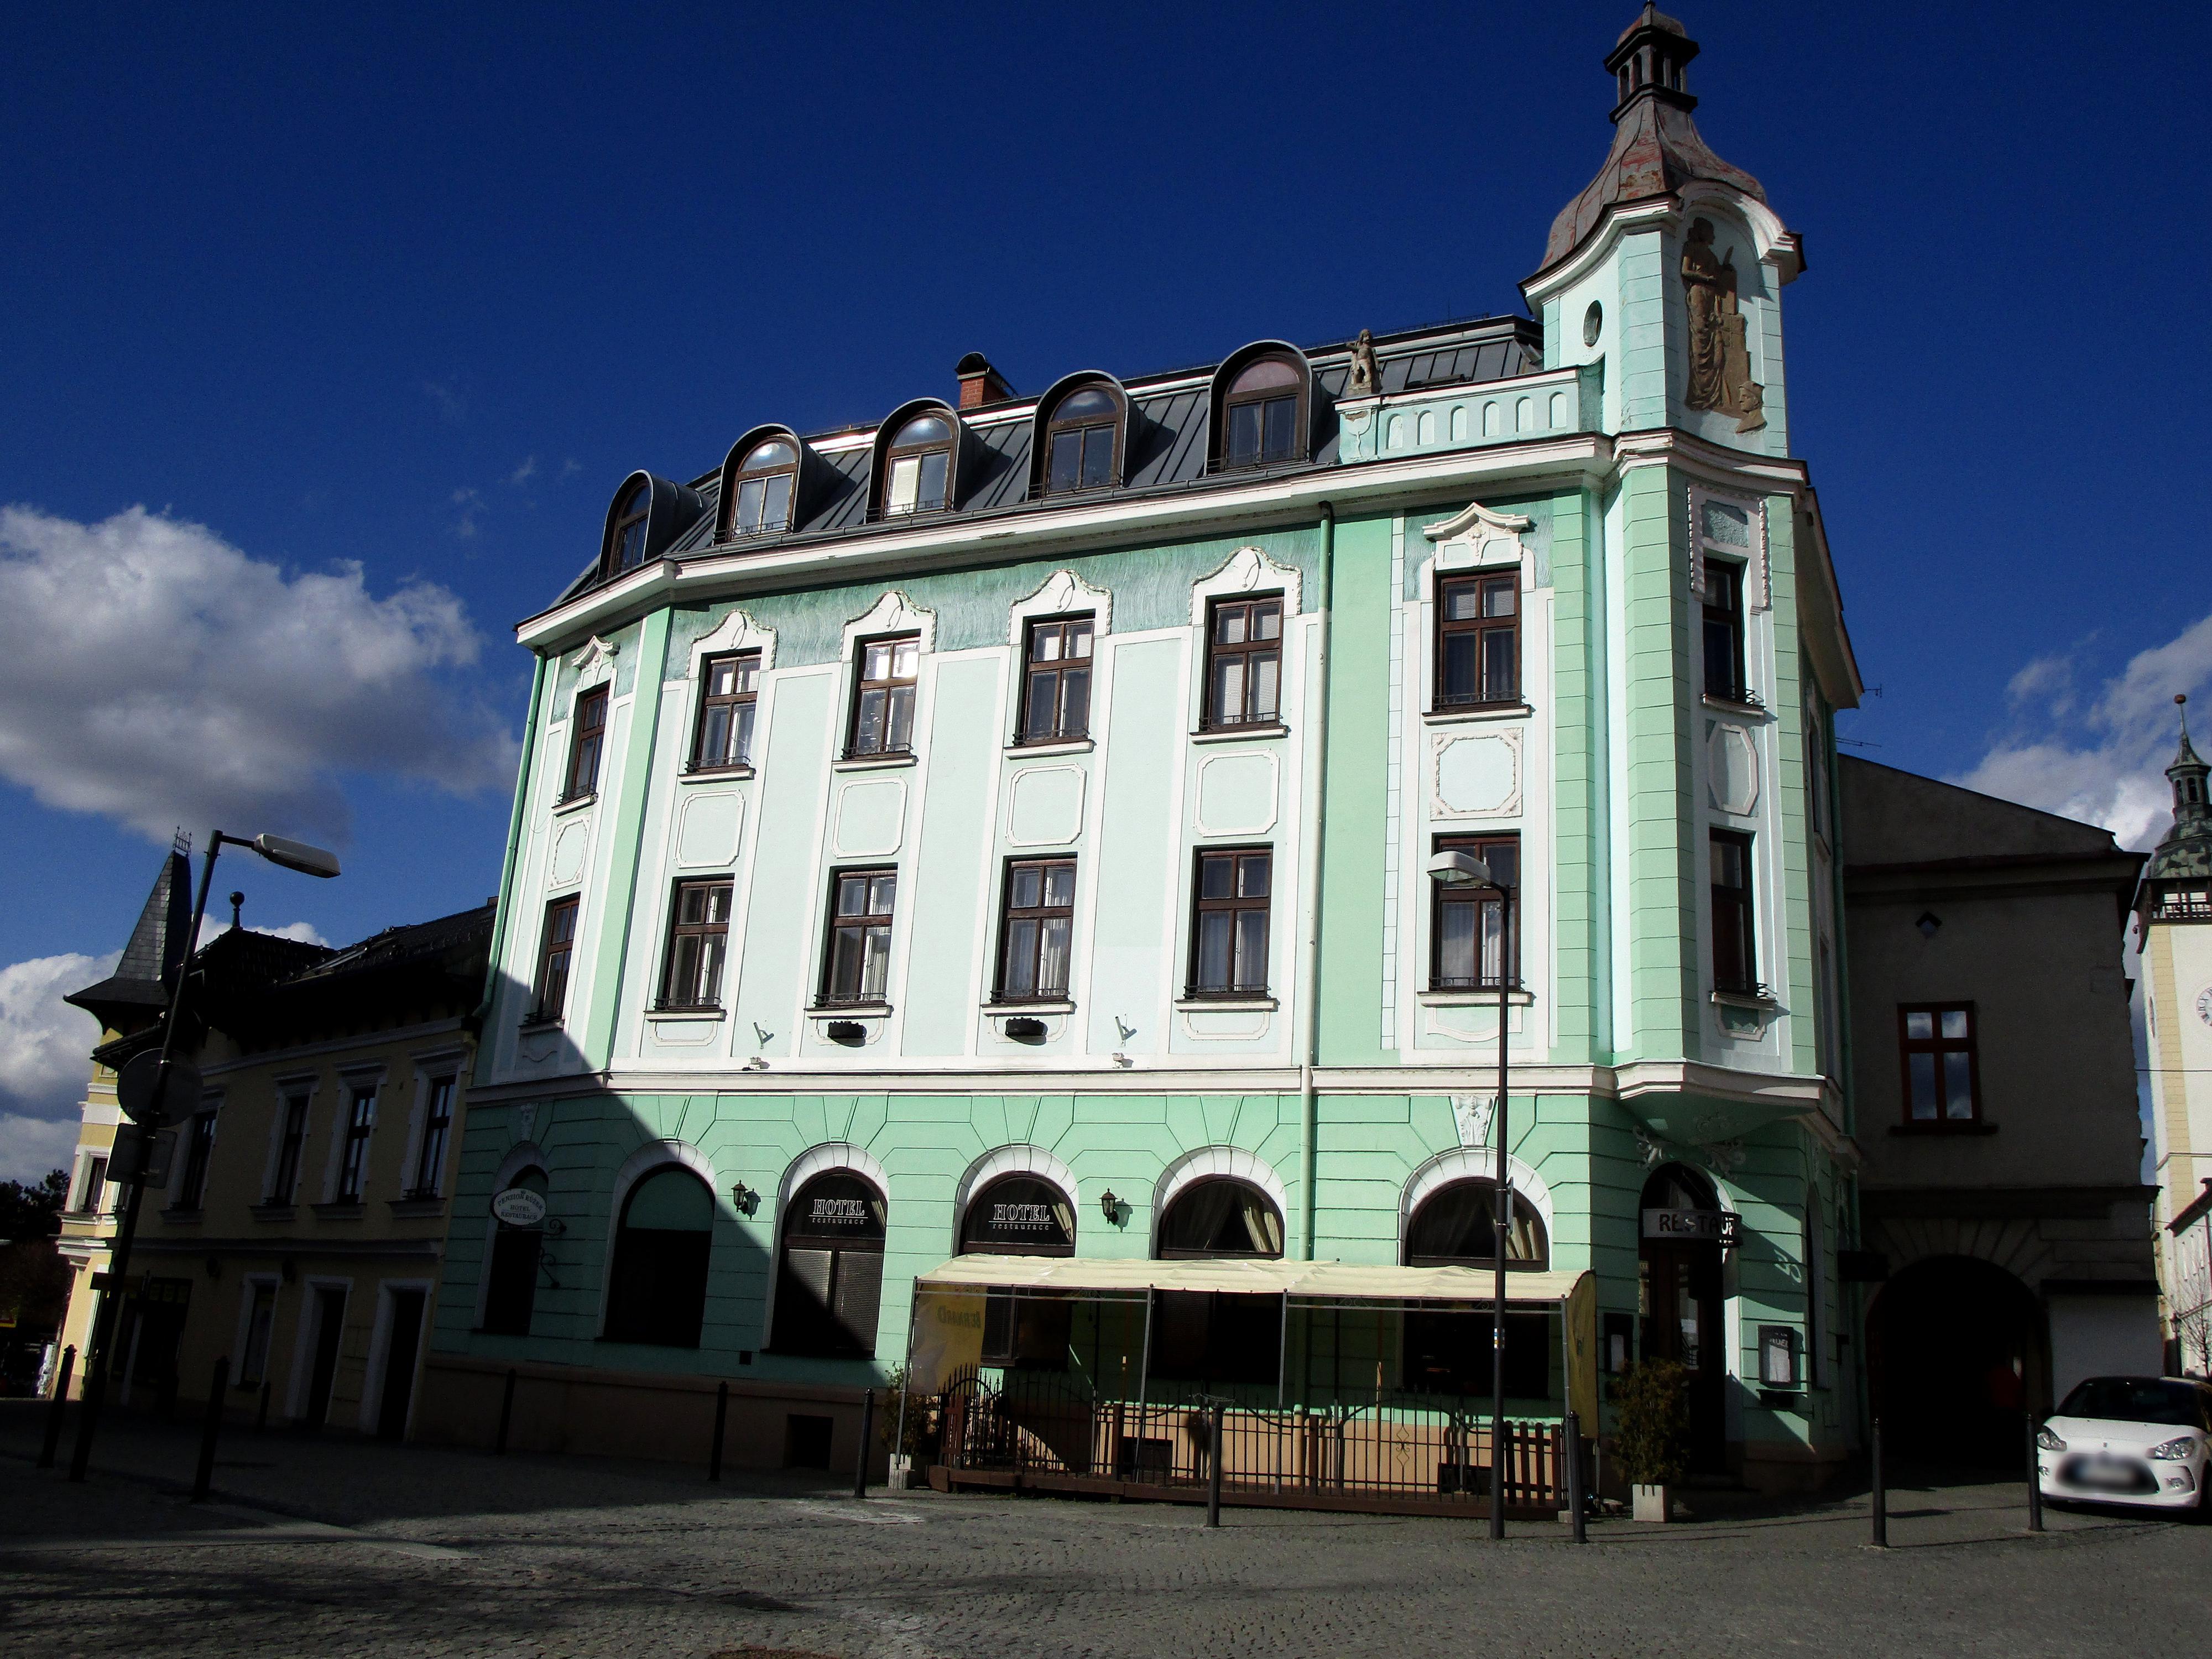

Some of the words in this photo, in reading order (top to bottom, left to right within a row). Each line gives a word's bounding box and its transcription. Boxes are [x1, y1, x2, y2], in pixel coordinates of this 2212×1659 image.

[498, 1193, 524, 1207] PENZION
[813, 1199, 865, 1216] HOTEL
[993, 1204, 1050, 1222] HOTEL
